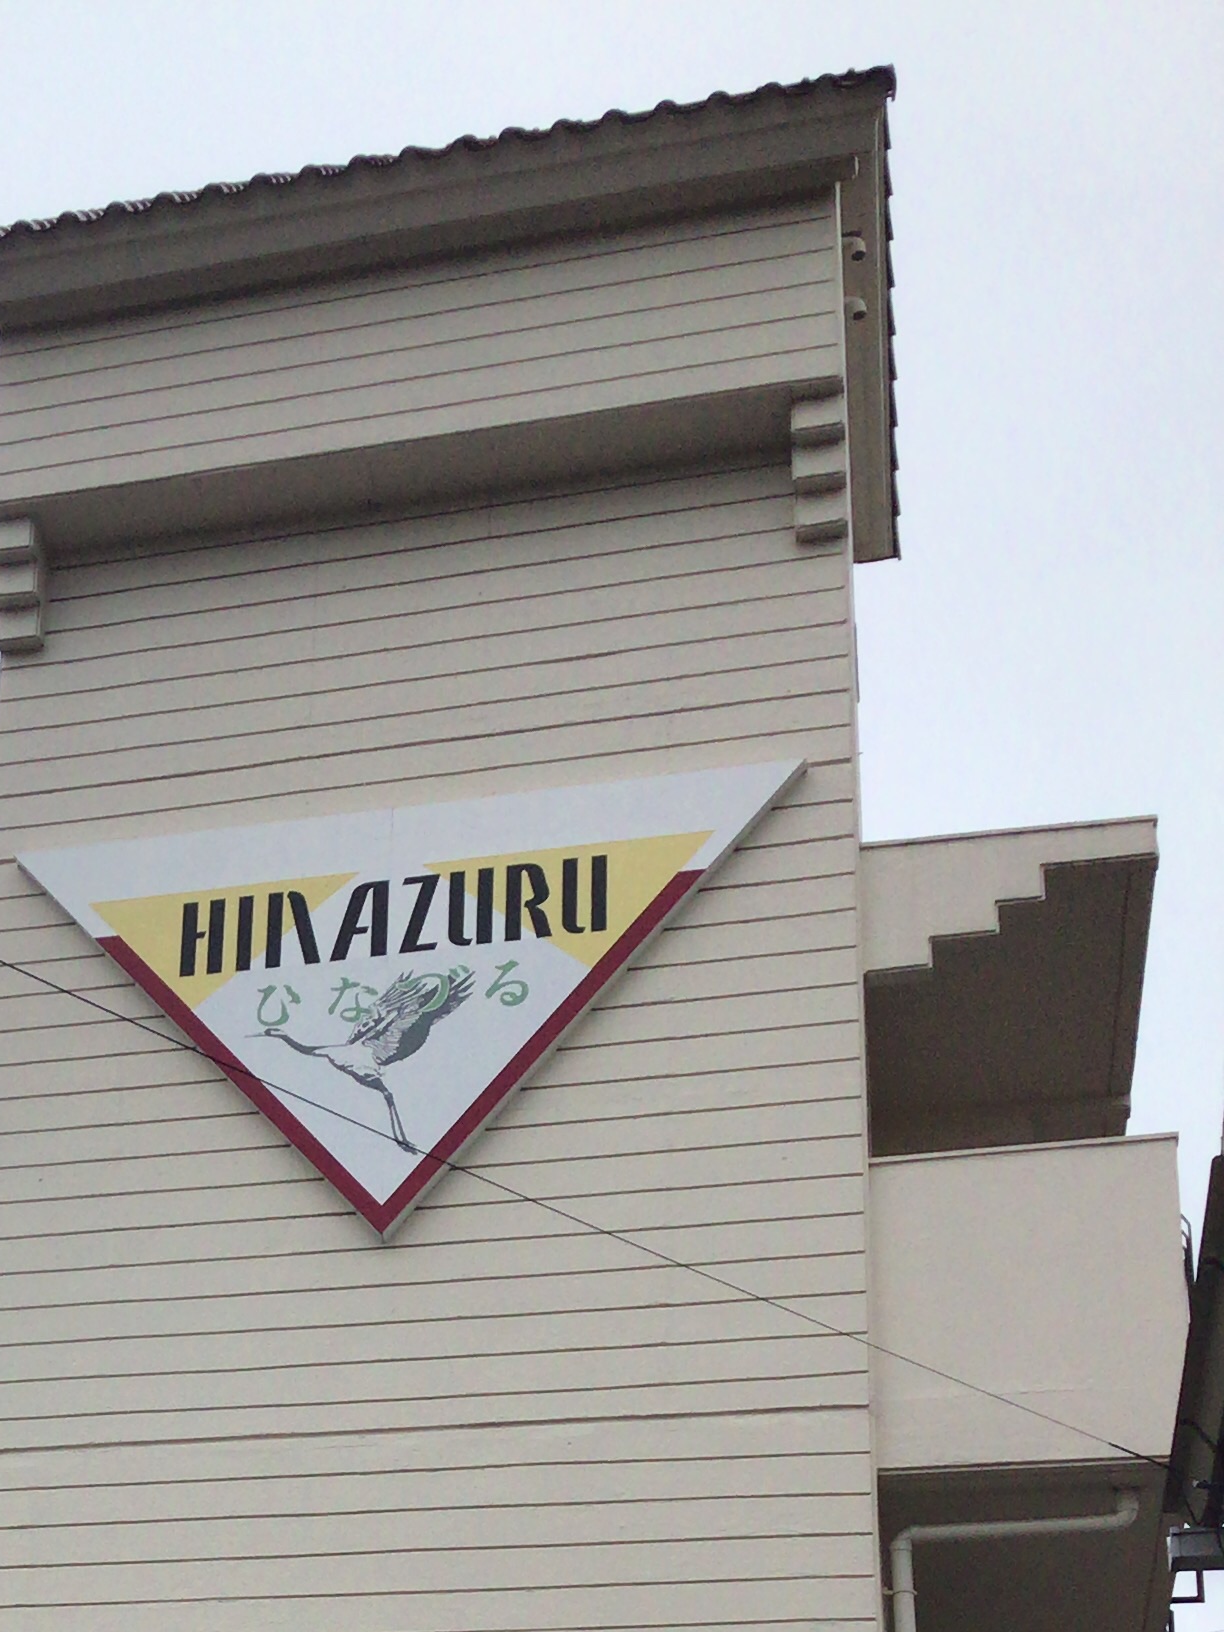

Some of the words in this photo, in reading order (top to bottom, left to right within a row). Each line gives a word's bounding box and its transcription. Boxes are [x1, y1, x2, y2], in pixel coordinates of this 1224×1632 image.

[179, 854, 609, 977] HINAZURU
[256, 960, 531, 1028] ひなづる
